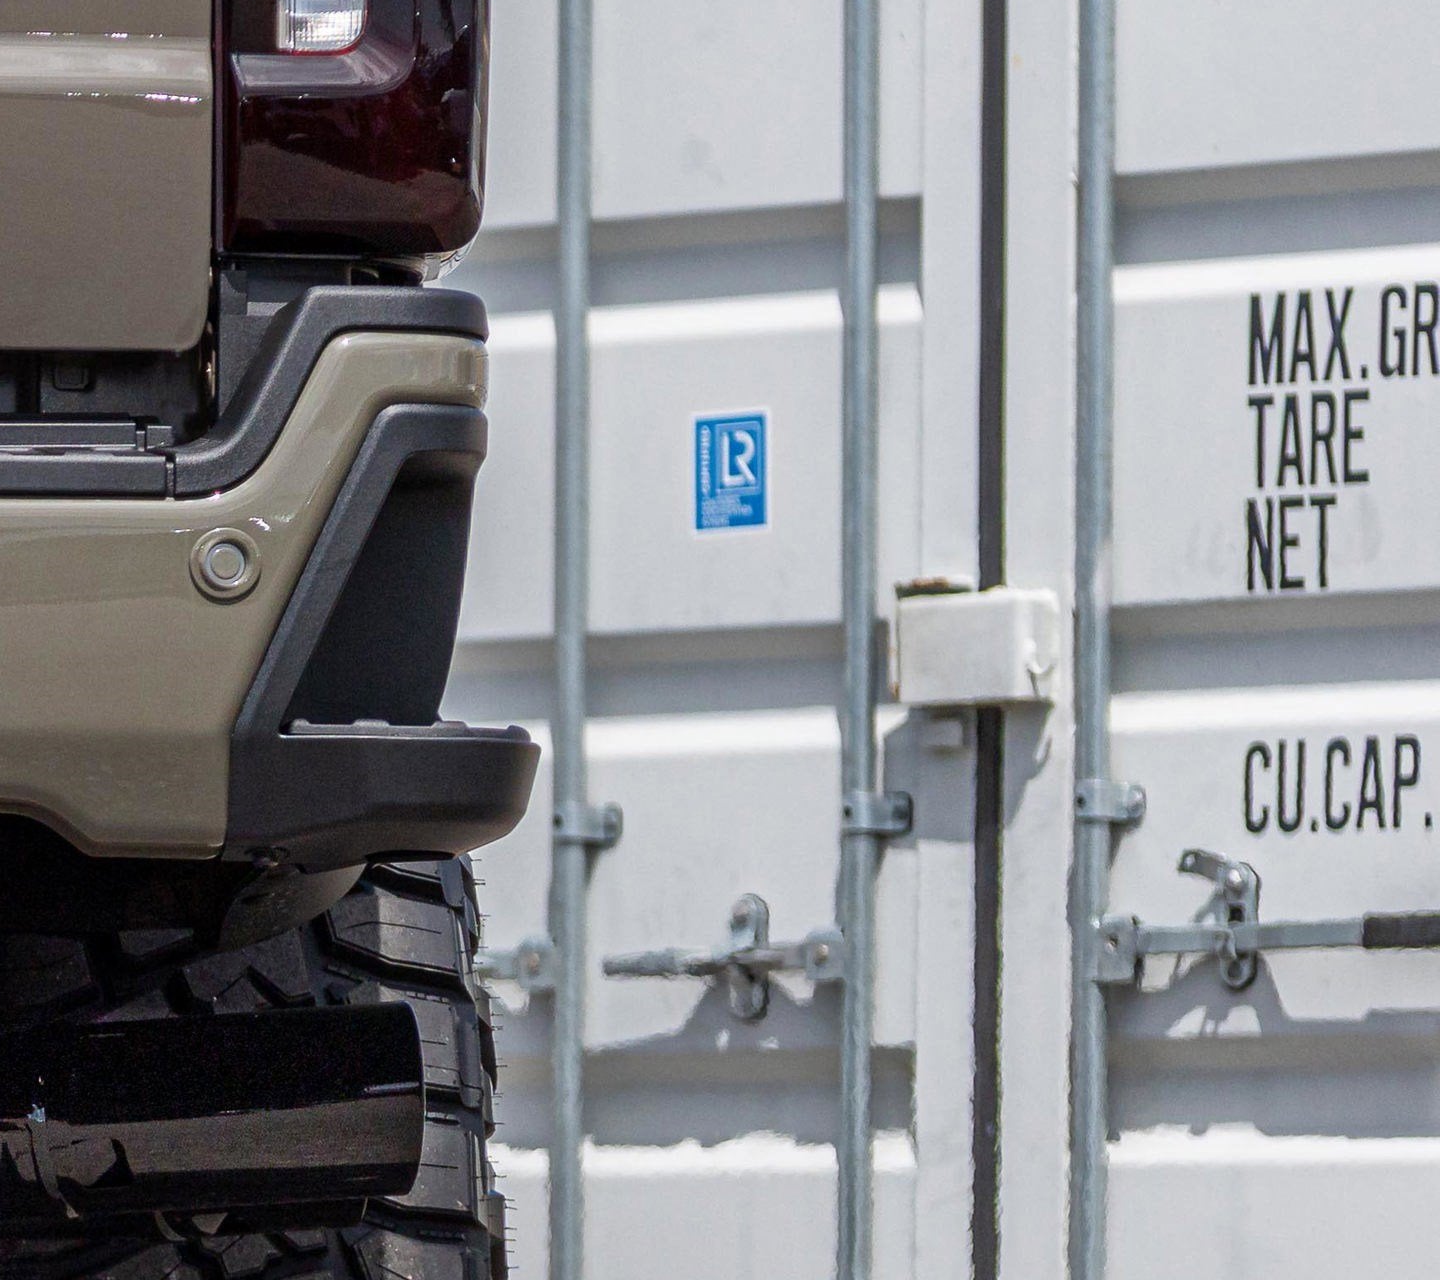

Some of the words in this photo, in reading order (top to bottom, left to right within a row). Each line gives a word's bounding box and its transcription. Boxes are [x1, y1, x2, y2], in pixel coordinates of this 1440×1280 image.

[1247, 388, 1370, 488] TARE
[1245, 493, 1337, 591] NET
[1244, 734, 1433, 835] CU.CAP.
